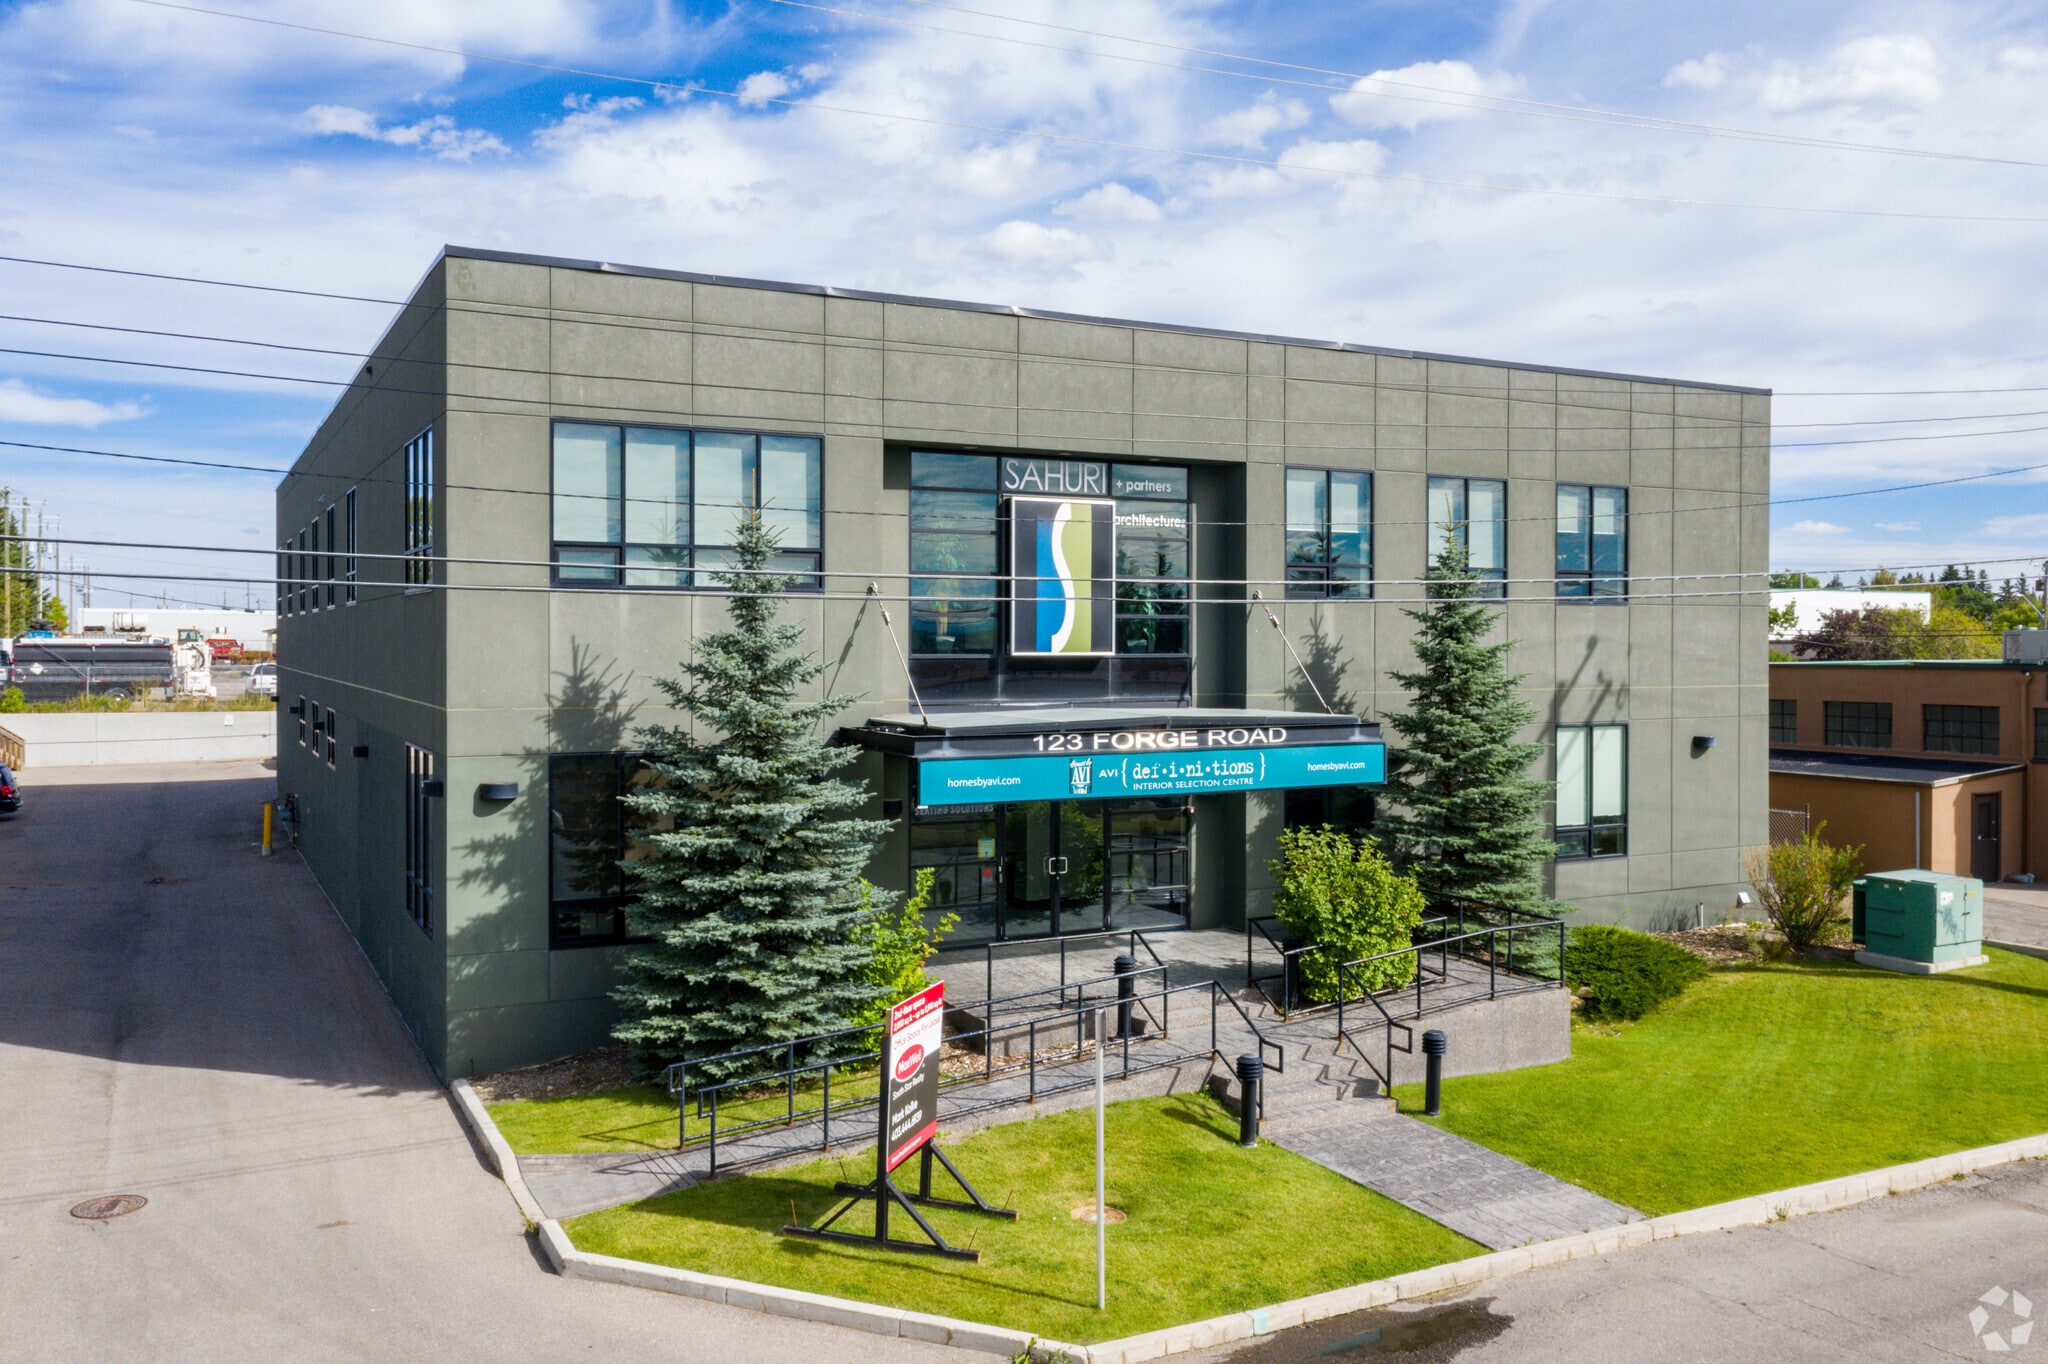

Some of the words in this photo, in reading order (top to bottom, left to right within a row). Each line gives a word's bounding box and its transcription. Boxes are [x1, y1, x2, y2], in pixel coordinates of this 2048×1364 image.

[1004, 459, 1106, 494] SAHURI
[1126, 479, 1172, 493] partners
[1033, 734, 1083, 751] 123
[1093, 730, 1199, 750] FORGE
[1208, 727, 1288, 746] ROAD
[1099, 768, 1118, 778] AVI
[1307, 760, 1366, 772] homesbyavi.com
[947, 776, 1021, 788] homesbyavi.com
[1071, 766, 1091, 784] AVI
[1133, 781, 1173, 791] INTERIOR
[1175, 779, 1220, 789] SELECTION
[1222, 777, 1254, 786] CENTRE
